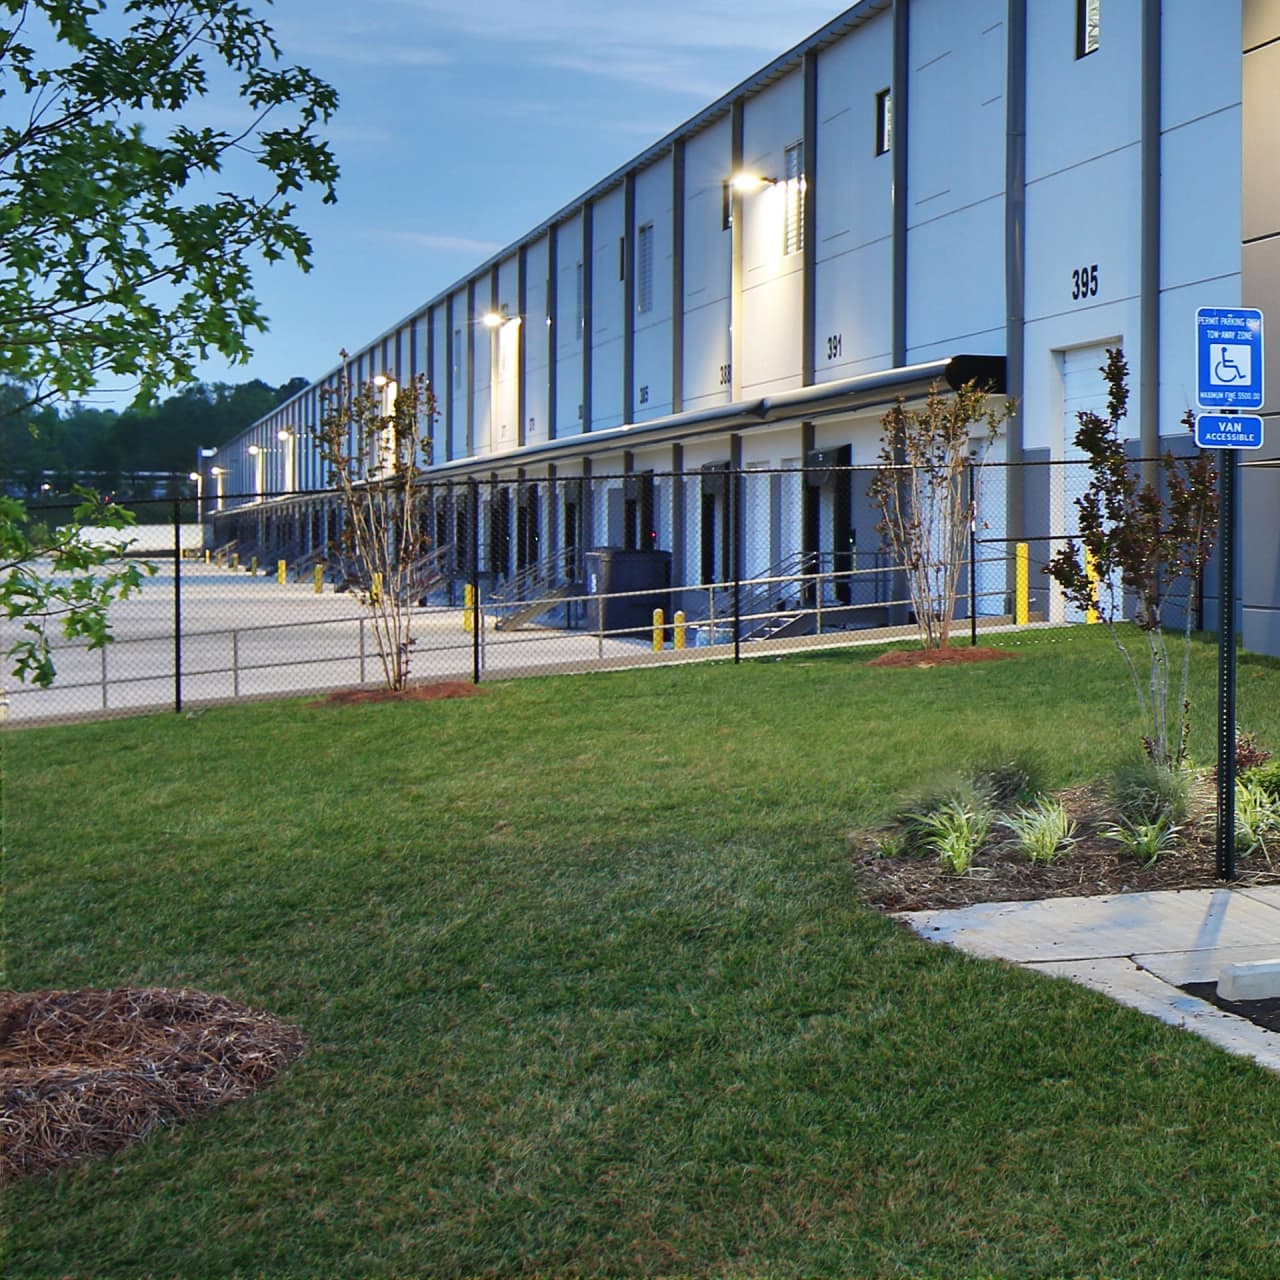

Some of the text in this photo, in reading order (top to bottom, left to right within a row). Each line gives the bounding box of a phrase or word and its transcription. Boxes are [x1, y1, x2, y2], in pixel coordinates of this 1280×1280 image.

[1071, 264, 1099, 300] 395
[827, 332, 842, 360] 391
[1218, 422, 1242, 433] VAN
[1205, 433, 1255, 442] ACCESSIBLE
